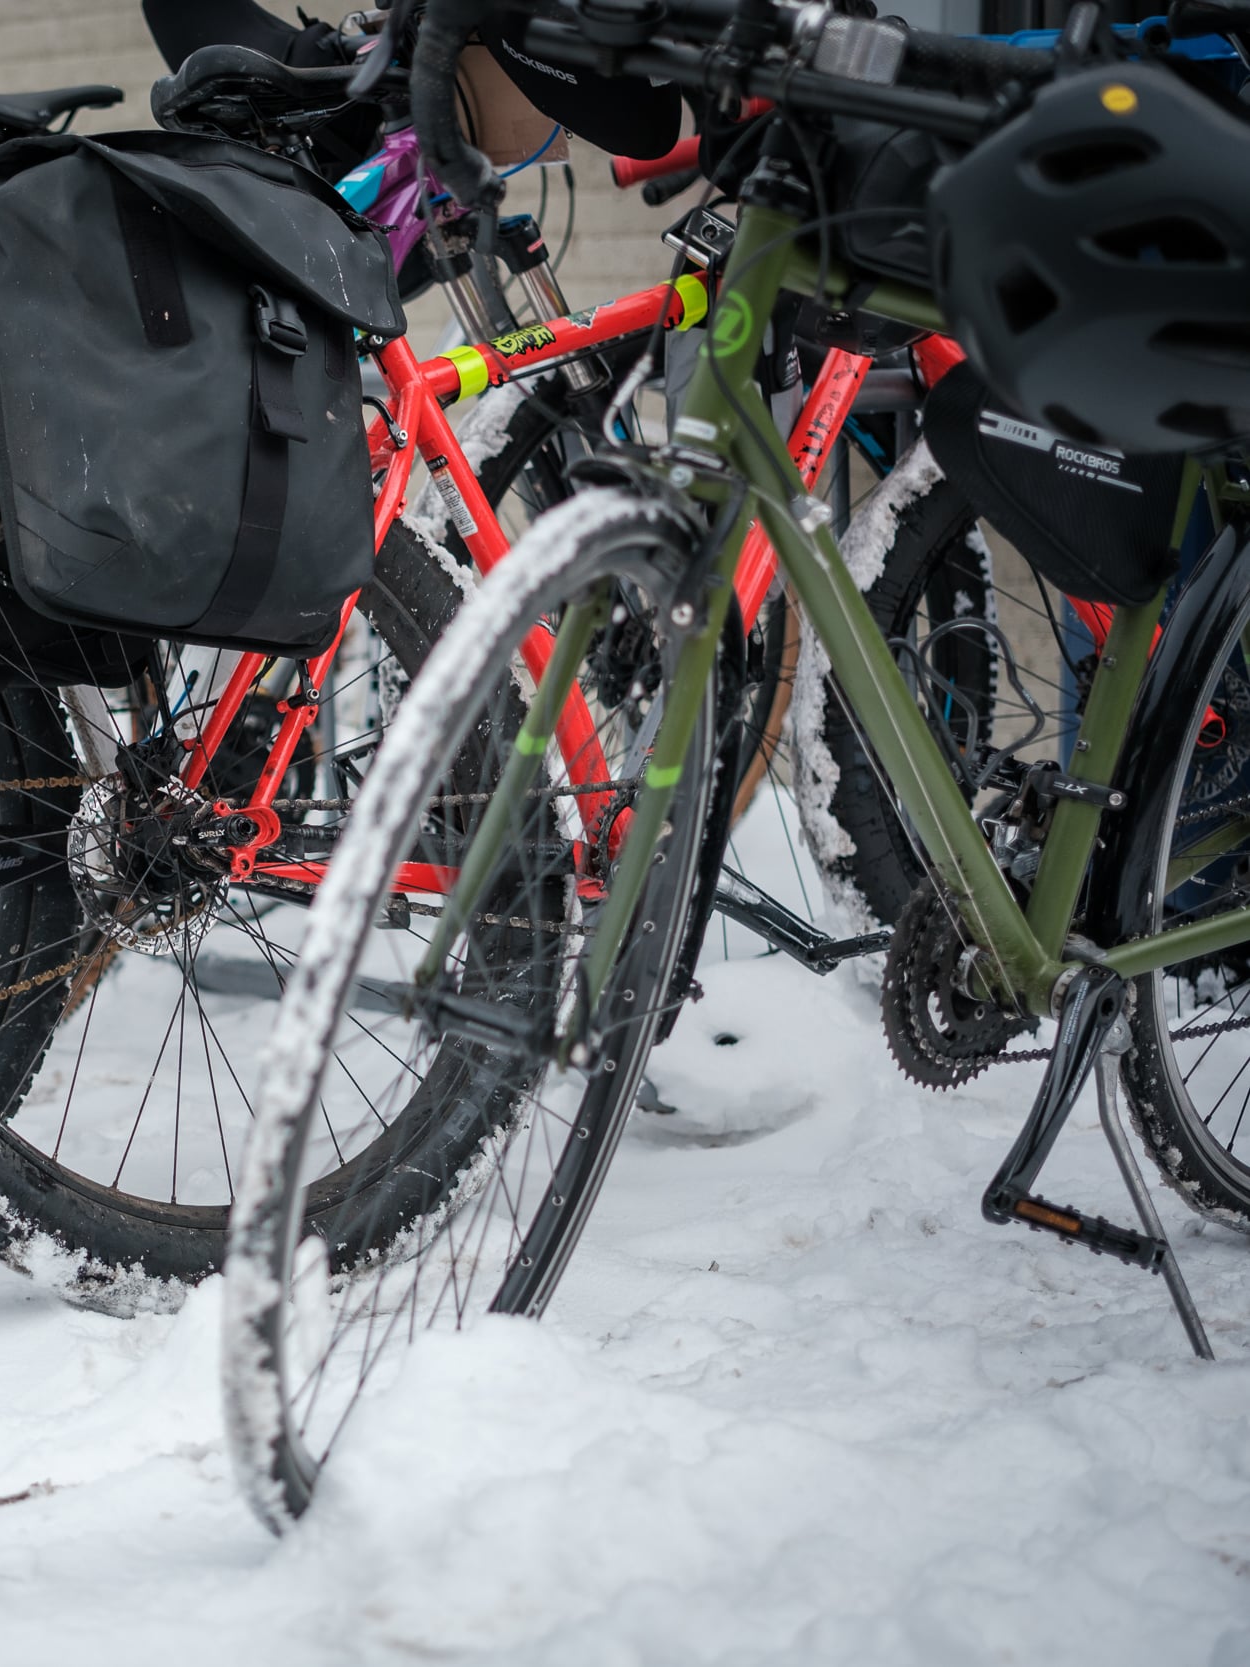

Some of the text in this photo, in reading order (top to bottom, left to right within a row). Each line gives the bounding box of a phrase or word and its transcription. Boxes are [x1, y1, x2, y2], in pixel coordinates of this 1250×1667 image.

[502, 38, 578, 85] ROCKBROS
[1055, 445, 1121, 474] ROCKBROS
[198, 829, 226, 840] SURLY
